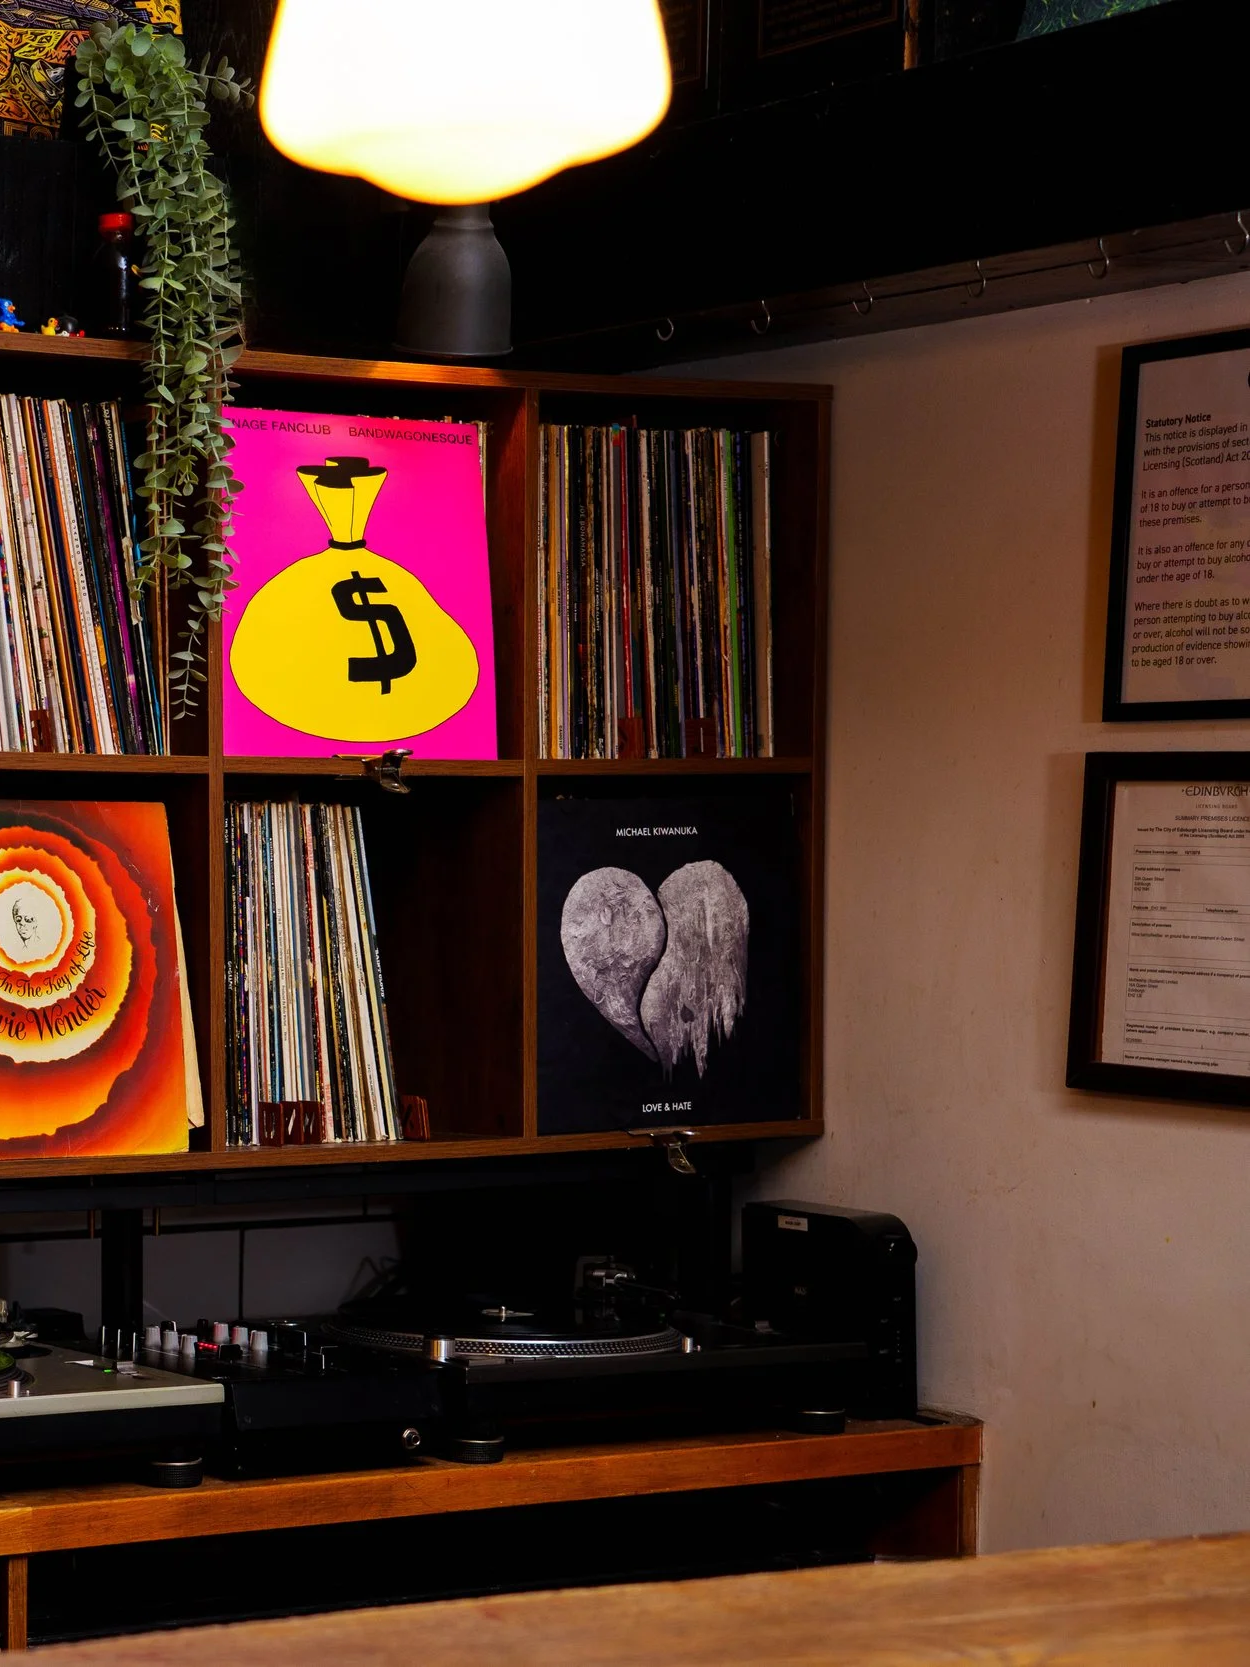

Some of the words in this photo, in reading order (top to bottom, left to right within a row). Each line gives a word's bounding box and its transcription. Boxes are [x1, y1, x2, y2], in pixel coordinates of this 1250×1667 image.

[1146, 417, 1183, 428] Statutory
[1185, 413, 1211, 424] Notice
[105, 419, 116, 451] SHADOW
[271, 420, 331, 435] FANCLUB
[348, 426, 473, 445] BANDWAGONESQUE
[1145, 433, 1161, 442] This
[1163, 430, 1187, 440] notice
[1189, 428, 1196, 437] is
[1199, 424, 1237, 437] displayed
[1240, 423, 1247, 431] in
[1144, 447, 1160, 456] with
[1163, 445, 1175, 454] the
[1178, 441, 1219, 453] provisions
[1222, 438, 1230, 448] of
[1143, 459, 1180, 471] Licensing
[1182, 452, 1224, 468] (Scotland)
[1226, 454, 1239, 462] Act
[1142, 490, 1147, 499] It
[1149, 489, 1155, 497] is
[1158, 489, 1167, 497] an
[1170, 486, 1198, 496] offence
[1201, 484, 1212, 493] for
[1215, 484, 1219, 492] a
[1222, 482, 1250, 492] person
[578, 504, 586, 520] JOE
[1141, 504, 1148, 513] of
[1150, 503, 1159, 512] 18
[1162, 503, 1169, 511] to
[1172, 500, 1186, 512] buy
[1188, 501, 1196, 509] or
[1199, 498, 1230, 508] attempt
[1140, 517, 1160, 527] these
[1163, 515, 1202, 529] premises.
[579, 520, 587, 567] BONAMASSA
[1138, 546, 1143, 555] It
[1146, 546, 1152, 555] is
[1154, 545, 1170, 555] also
[1173, 544, 1182, 553] an
[1185, 542, 1214, 552] offence
[1216, 540, 1227, 549] for
[1230, 540, 1245, 550] any
[1137, 560, 1151, 571] buy
[1164, 558, 1195, 568] attempt
[1197, 557, 1205, 565] to
[1208, 556, 1222, 566] buy
[1136, 575, 1159, 583] under
[1162, 573, 1173, 582] the
[1176, 573, 1190, 583] age
[1204, 570, 1214, 579] 18.
[1135, 602, 1160, 611] Where
[1162, 601, 1183, 610] there
[1185, 601, 1192, 609] is
[1194, 598, 1218, 608] doubt
[1220, 598, 1229, 606] as
[1232, 598, 1240, 606] to
[1134, 618, 1161, 627] person
[1163, 613, 1206, 625] attempting
[1219, 613, 1233, 622] buy
[1133, 631, 1141, 639] or
[1144, 631, 1163, 639] over,
[1165, 628, 1193, 638] alcohol
[1196, 627, 1210, 636] will
[1213, 627, 1226, 635] not
[1228, 626, 1238, 635] be
[1132, 643, 1174, 654] production
[1176, 642, 1183, 651] of
[1186, 641, 1222, 651] evidence
[1132, 659, 1139, 667] to
[1141, 658, 1150, 666] be
[1153, 657, 1172, 668] aged
[1175, 656, 1183, 665] 18
[1186, 657, 1194, 665] or
[1196, 656, 1217, 664] over.
[616, 827, 651, 837] MICHAEL
[653, 826, 698, 836] KIWANUKA
[73, 931, 96, 962] Life
[69, 960, 86, 976] of
[16, 978, 43, 998] The
[45, 973, 73, 995] Key
[26, 985, 107, 1041] Wonder
[642, 1103, 662, 1112] LOVE
[664, 1103, 670, 1111] &
[672, 1101, 692, 1110] HATE
